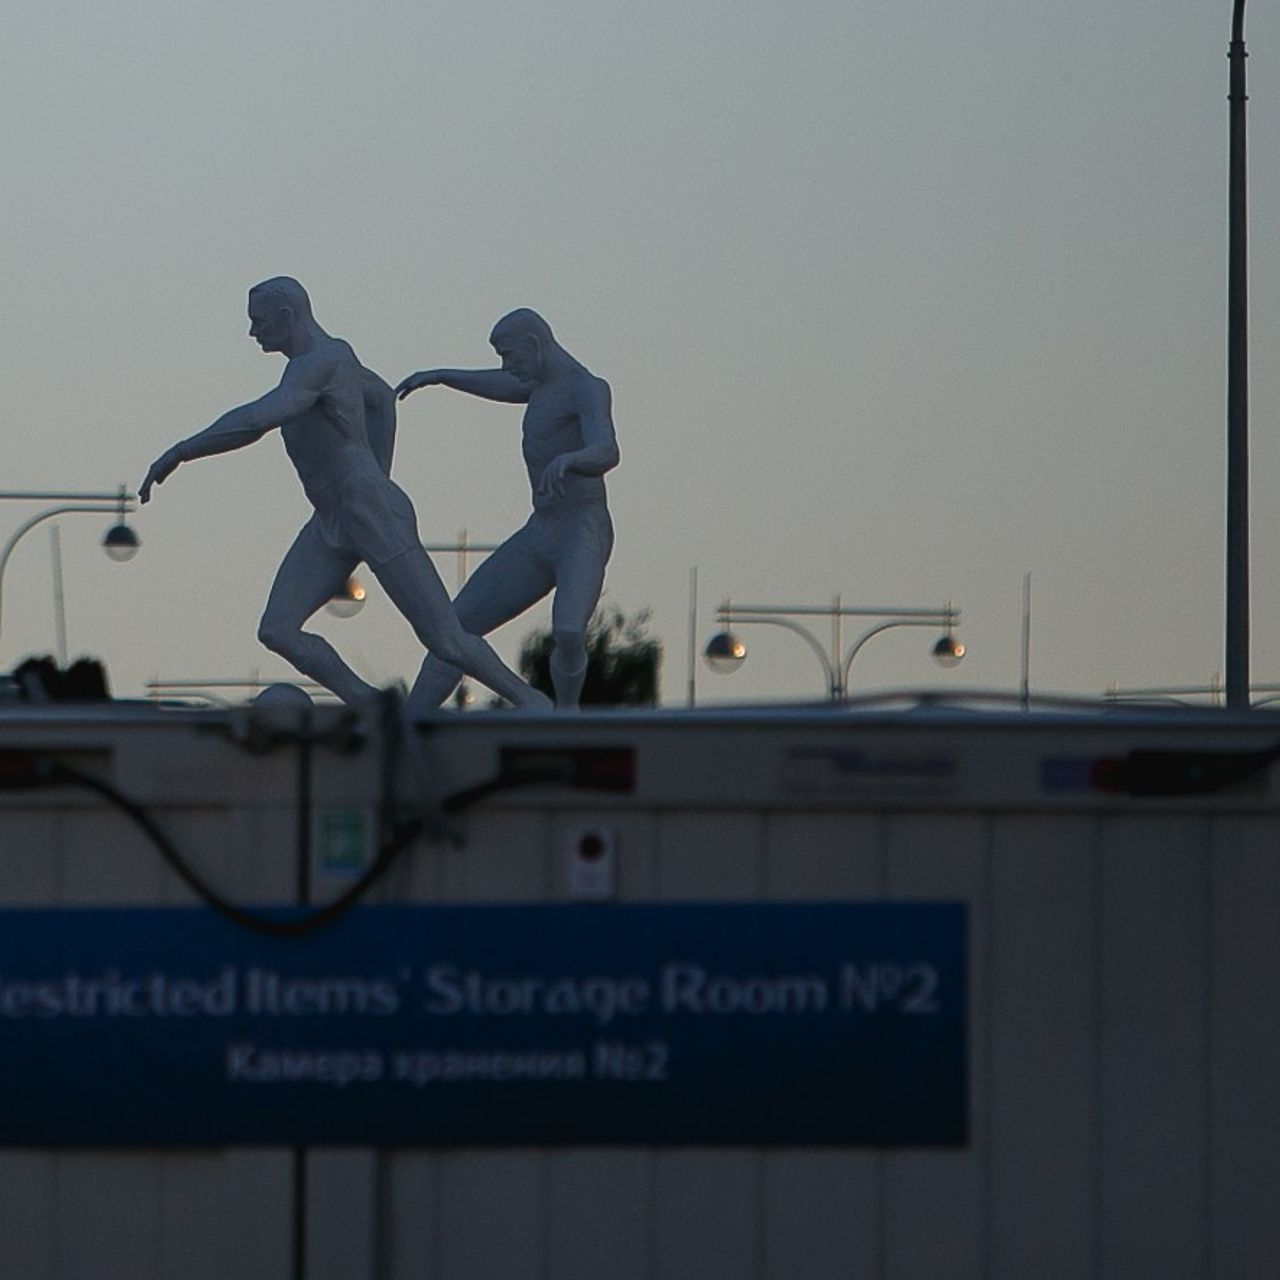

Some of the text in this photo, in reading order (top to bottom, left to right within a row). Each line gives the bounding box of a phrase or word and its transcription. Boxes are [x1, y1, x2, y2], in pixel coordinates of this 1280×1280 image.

[425, 962, 651, 1024] Storage
[659, 961, 828, 1016] Room
[223, 1040, 384, 1088] Камера
[391, 1047, 587, 1088] хранения
